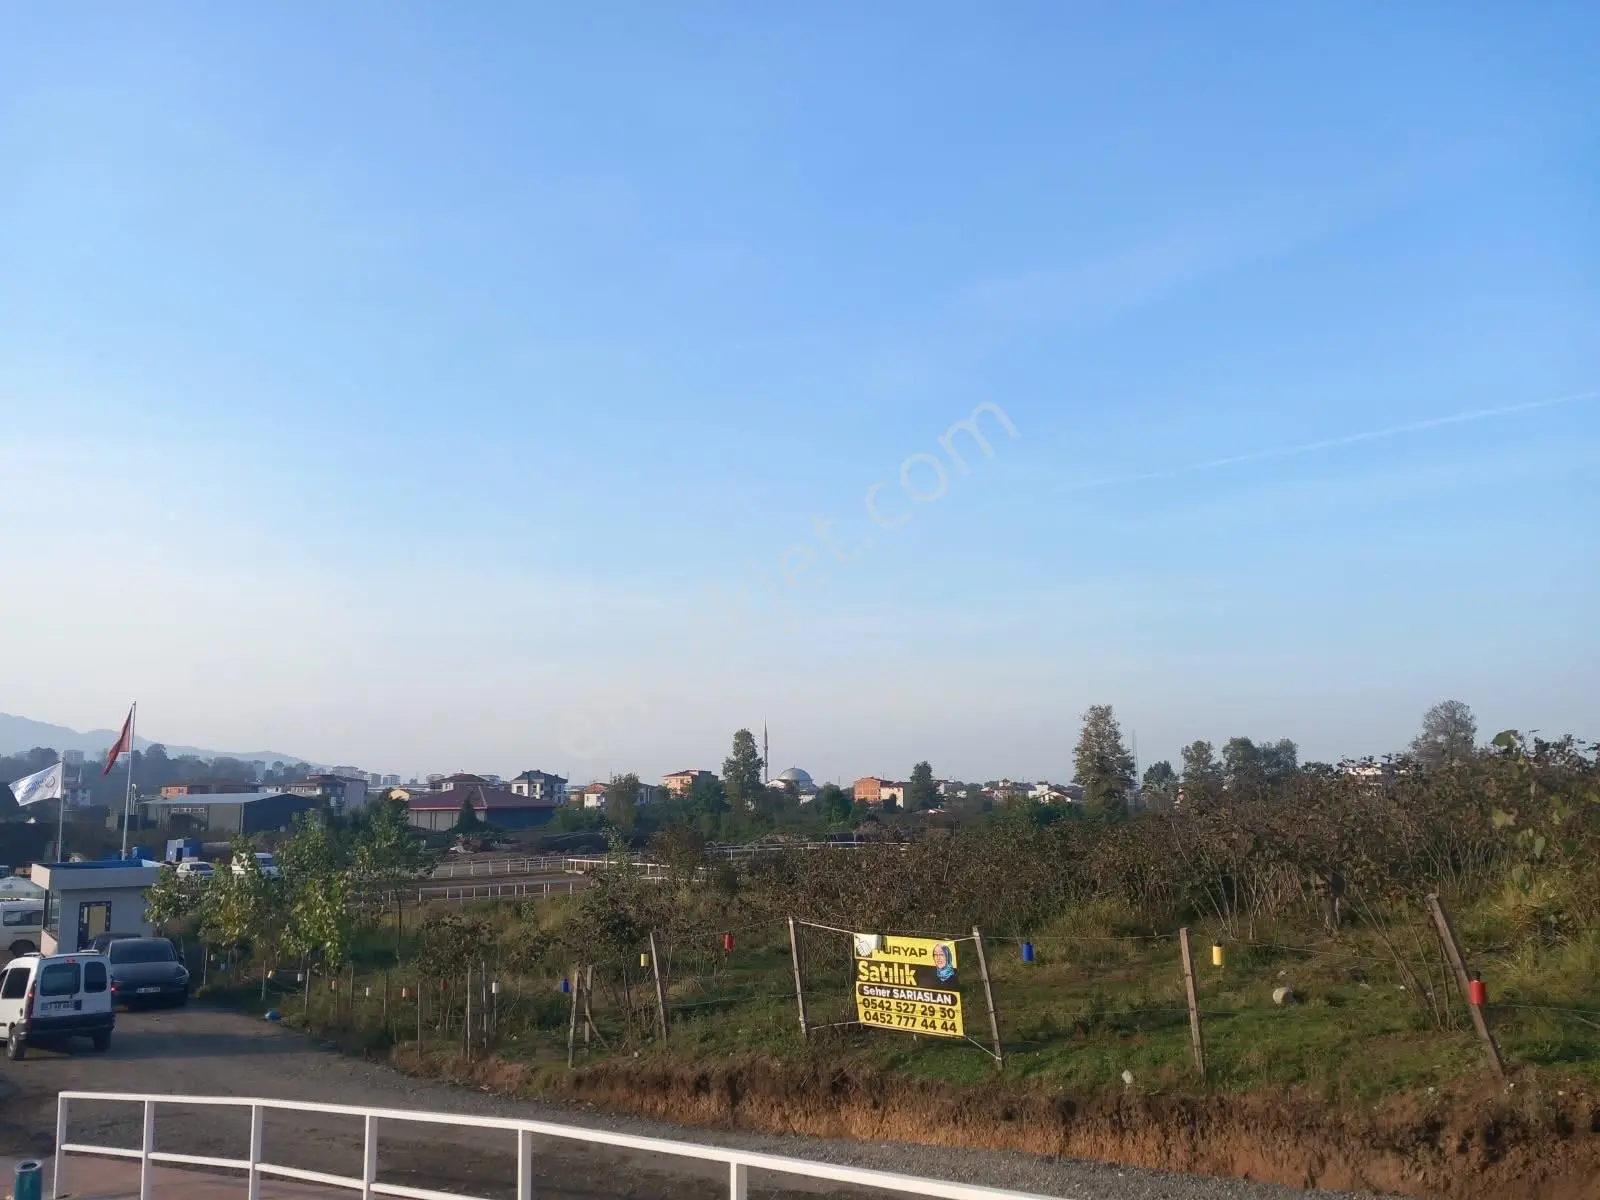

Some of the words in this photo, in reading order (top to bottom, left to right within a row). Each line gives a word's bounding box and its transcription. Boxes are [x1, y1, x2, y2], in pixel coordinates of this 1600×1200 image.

[858, 960, 917, 986] Satılık
[863, 986, 893, 998] Seher
[893, 989, 952, 1005] SARIASLAN
[862, 998, 892, 1012] 0542
[895, 1001, 917, 1014] 527
[921, 1005, 936, 1017] 29
[940, 1007, 956, 1019] 30
[864, 1011, 893, 1025] 0452
[896, 1014, 917, 1028] 777
[921, 1018, 937, 1031] 44
[941, 1020, 957, 1034] 44
